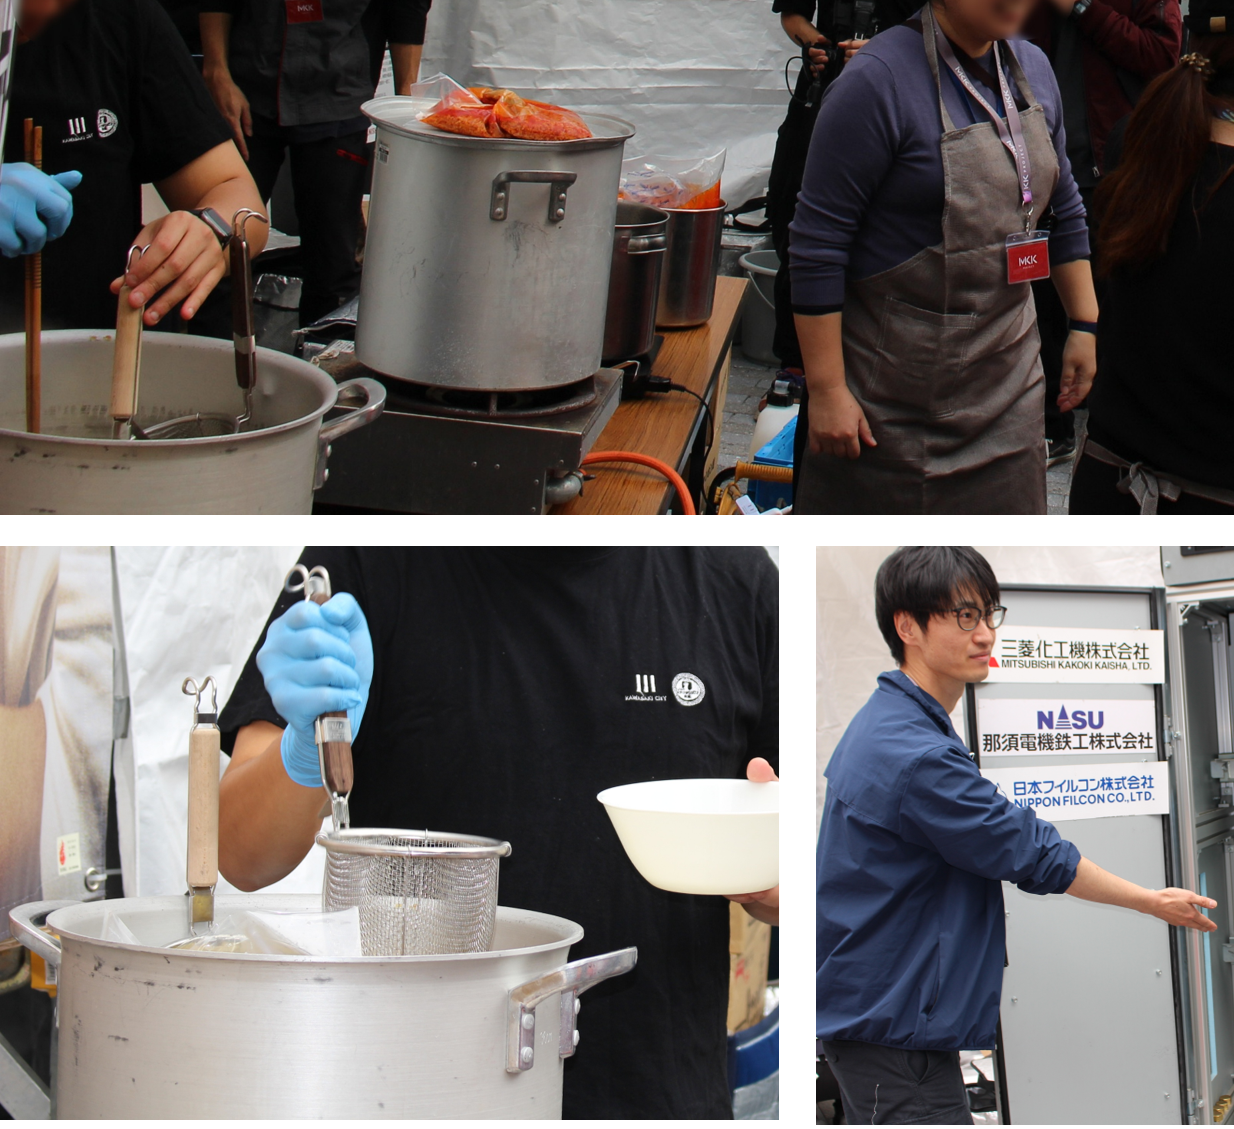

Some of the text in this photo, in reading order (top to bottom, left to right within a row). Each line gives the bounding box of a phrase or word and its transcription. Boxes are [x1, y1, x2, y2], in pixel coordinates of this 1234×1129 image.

[297, 4, 314, 12] MKK
[955, 66, 970, 86] MKK
[1003, 90, 1014, 109] MKK
[1018, 254, 1038, 266] MKK
[1001, 639, 1150, 660] 三菱化工機株式会社
[1001, 659, 1152, 671] MITSUBISHI KAKOKI KAISHA, LTD.
[1037, 704, 1104, 730] NASU
[982, 732, 1154, 752] 那須電機鉄工株式会社
[1013, 775, 1155, 796] 日本フイルコン株式会社
[1014, 795, 1061, 809] NIPPON
[1063, 792, 1108, 806] FILCON
